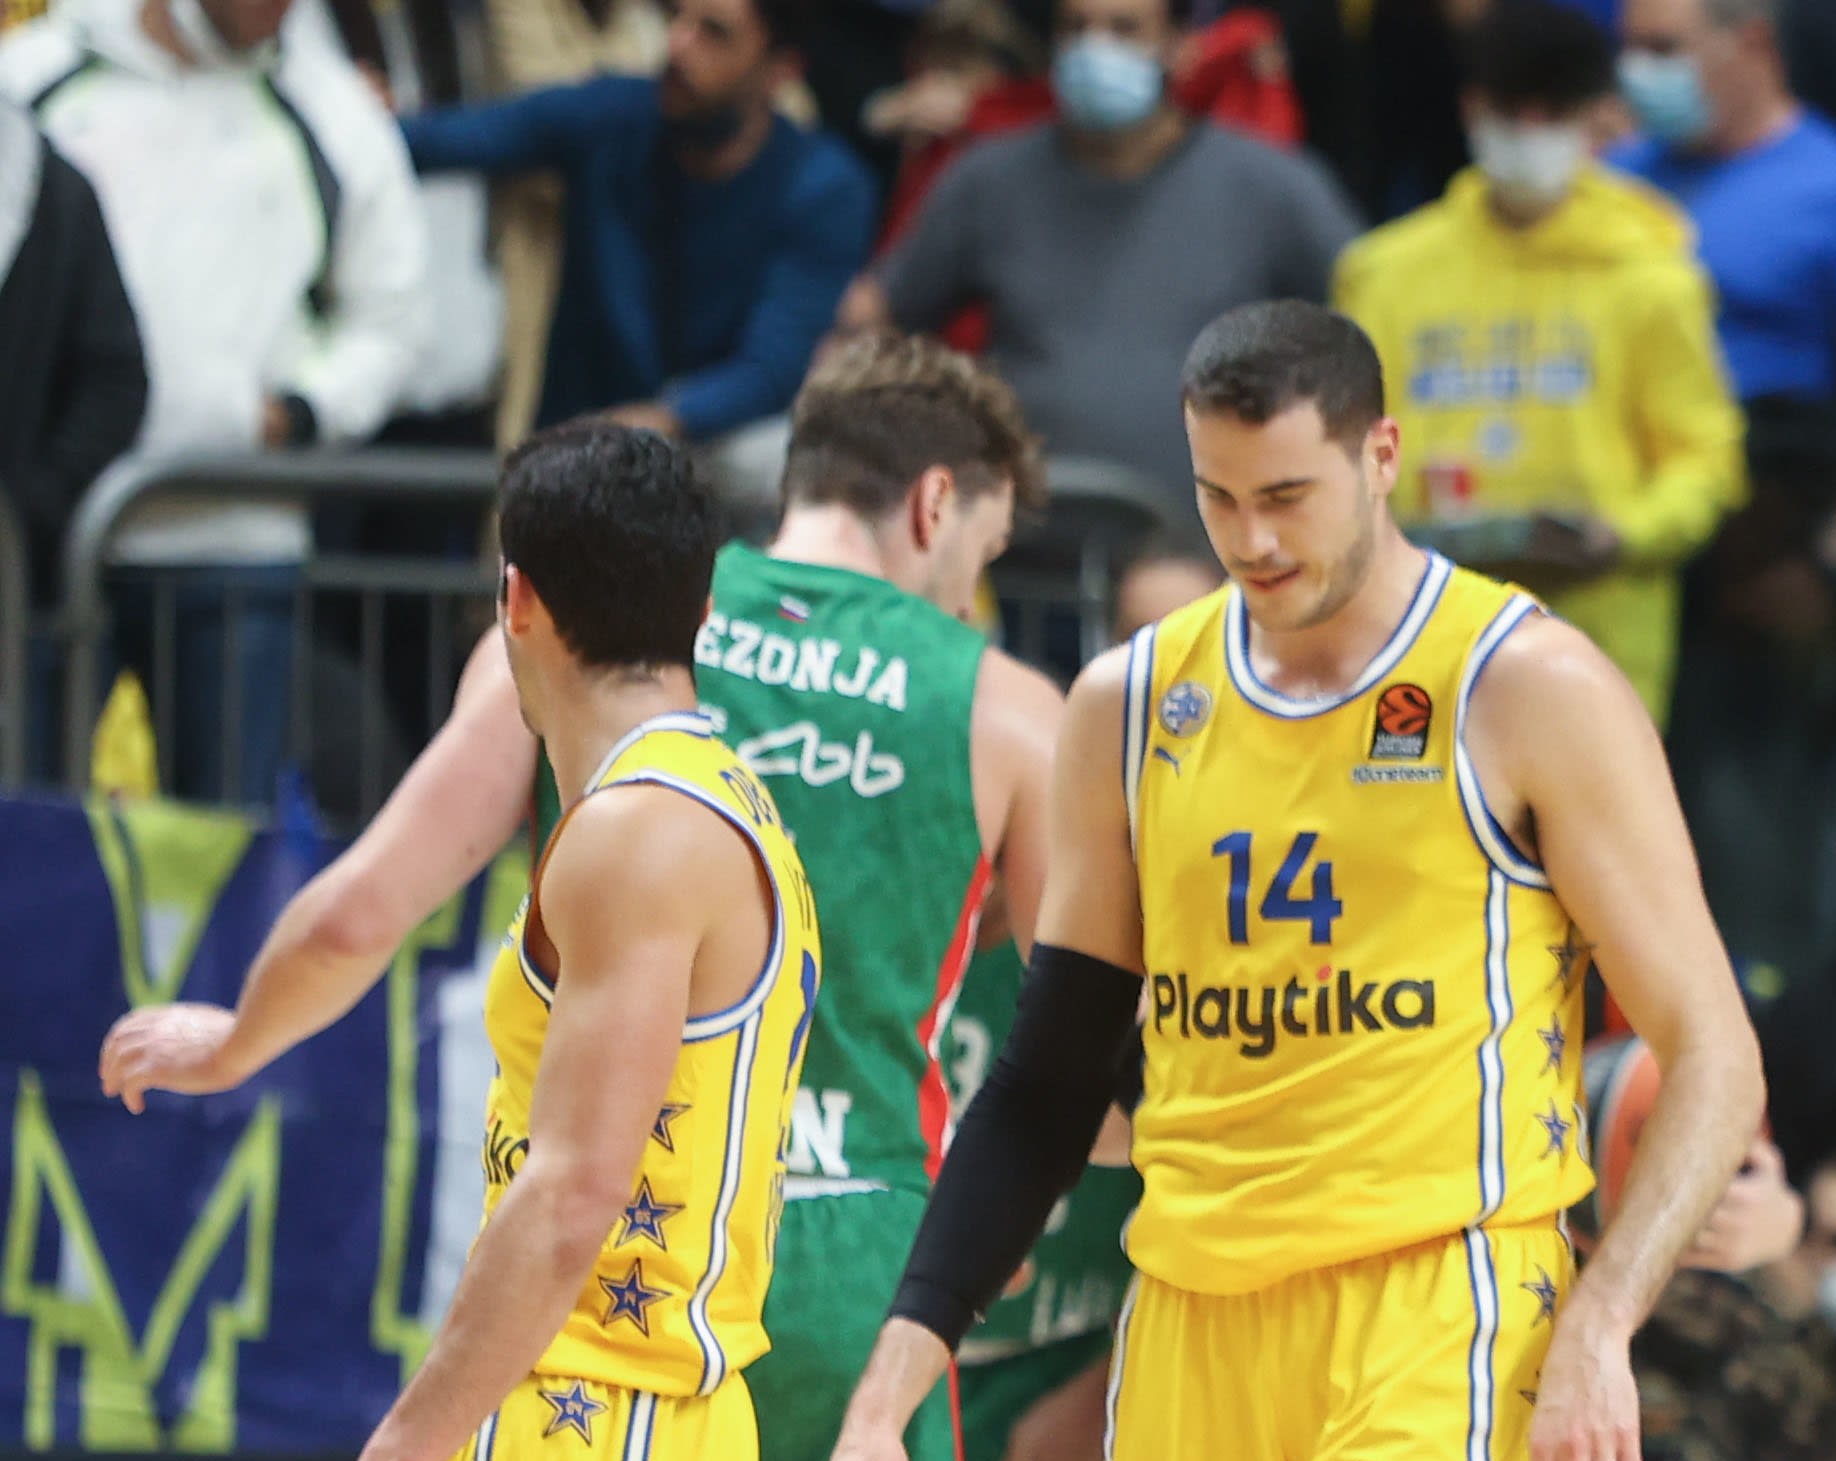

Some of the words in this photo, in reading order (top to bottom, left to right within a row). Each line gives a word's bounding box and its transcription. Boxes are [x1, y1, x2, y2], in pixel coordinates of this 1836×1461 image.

[694, 612, 908, 712] EZONJA
[1212, 831, 1343, 946] 14
[1152, 966, 1436, 1059] Playtika
